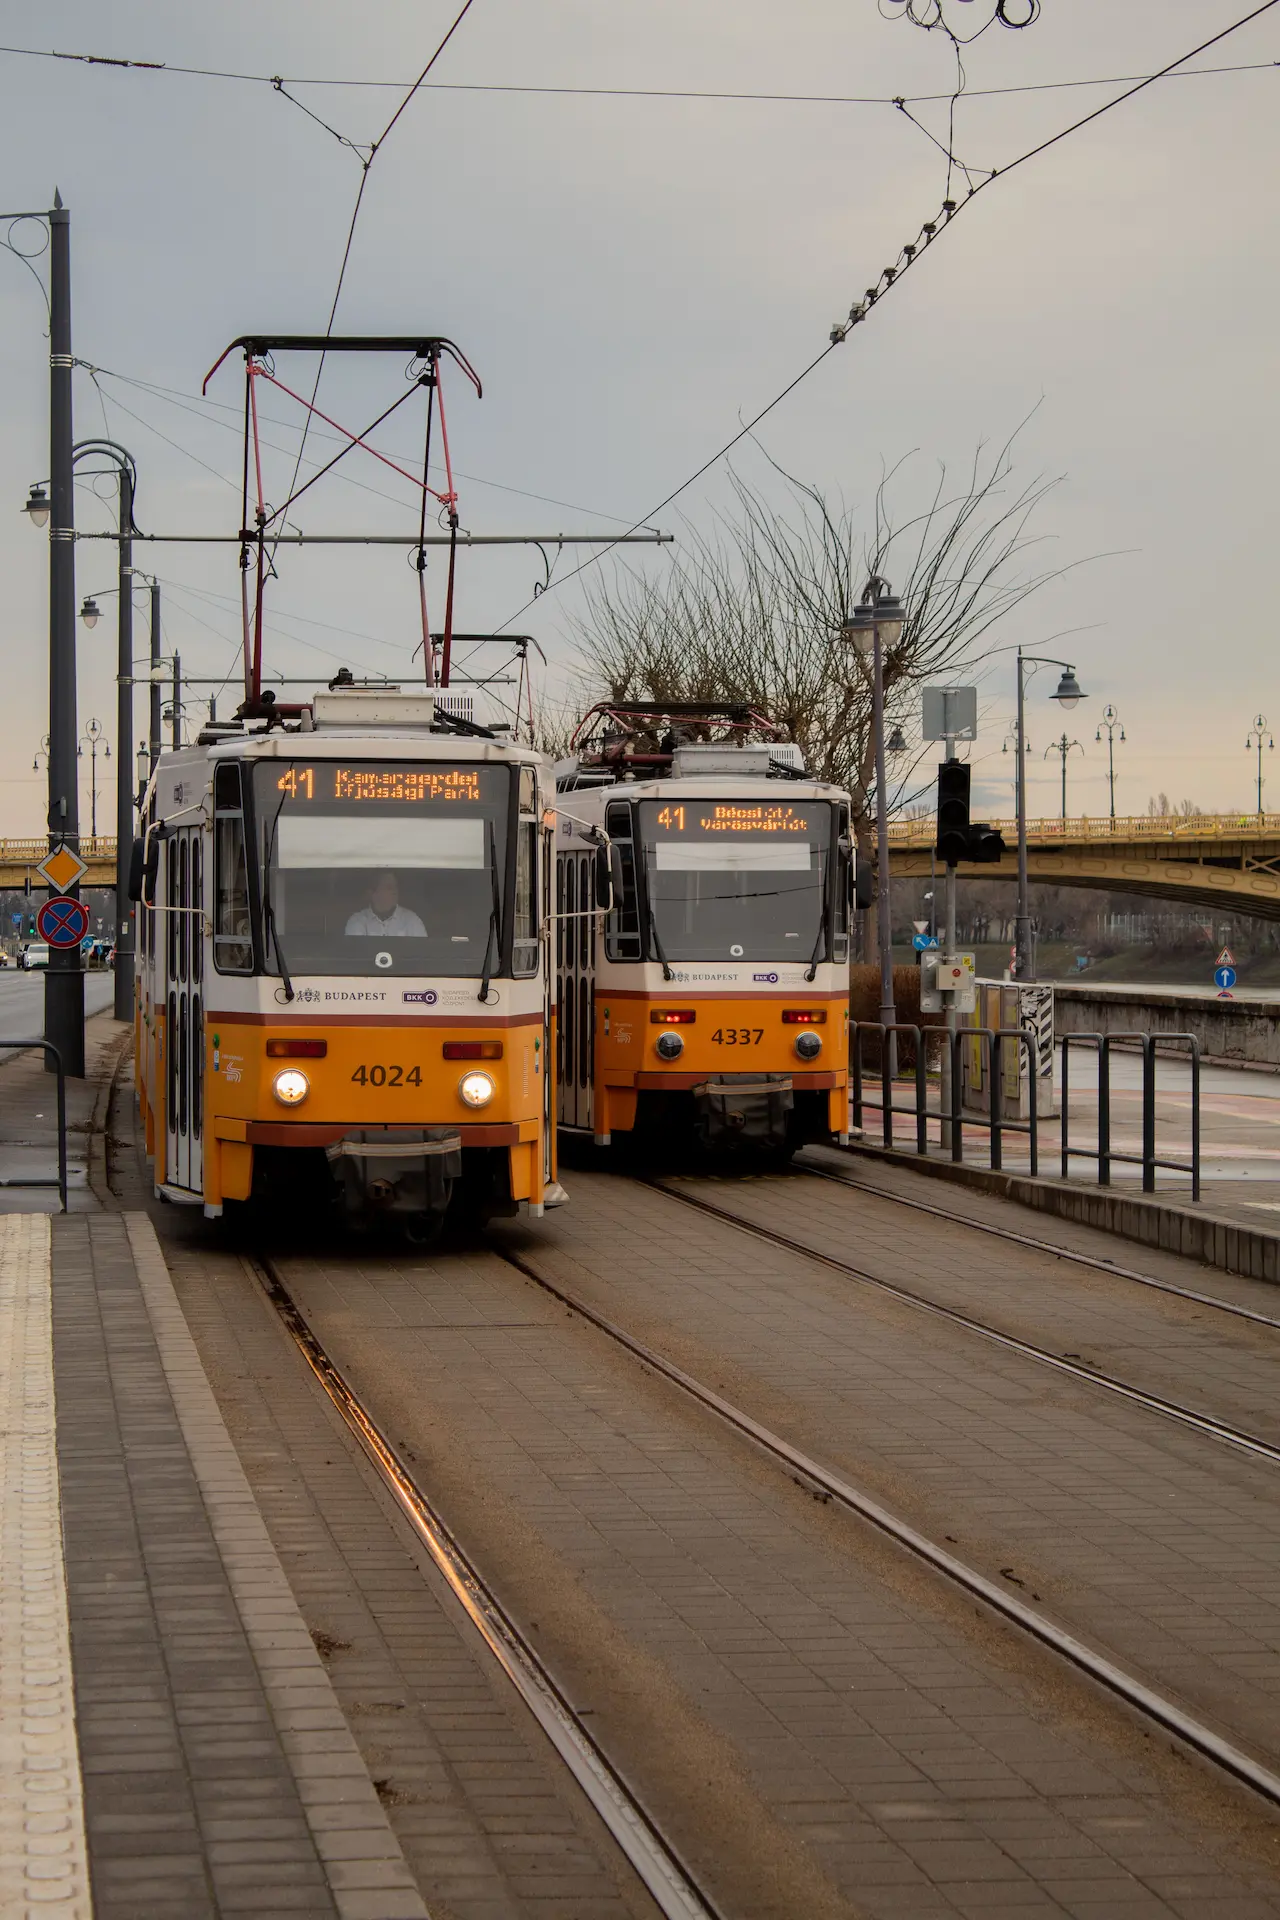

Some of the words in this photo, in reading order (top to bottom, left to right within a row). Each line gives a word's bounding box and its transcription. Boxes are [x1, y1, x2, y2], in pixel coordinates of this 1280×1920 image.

[277, 768, 315, 799] 41
[430, 785, 480, 800] Park
[658, 806, 685, 830] 41
[693, 973, 739, 982] BUDAPEST
[325, 991, 387, 1001] BUDAPEST
[711, 1028, 765, 1046] 4337
[351, 1064, 423, 1088] 4024
